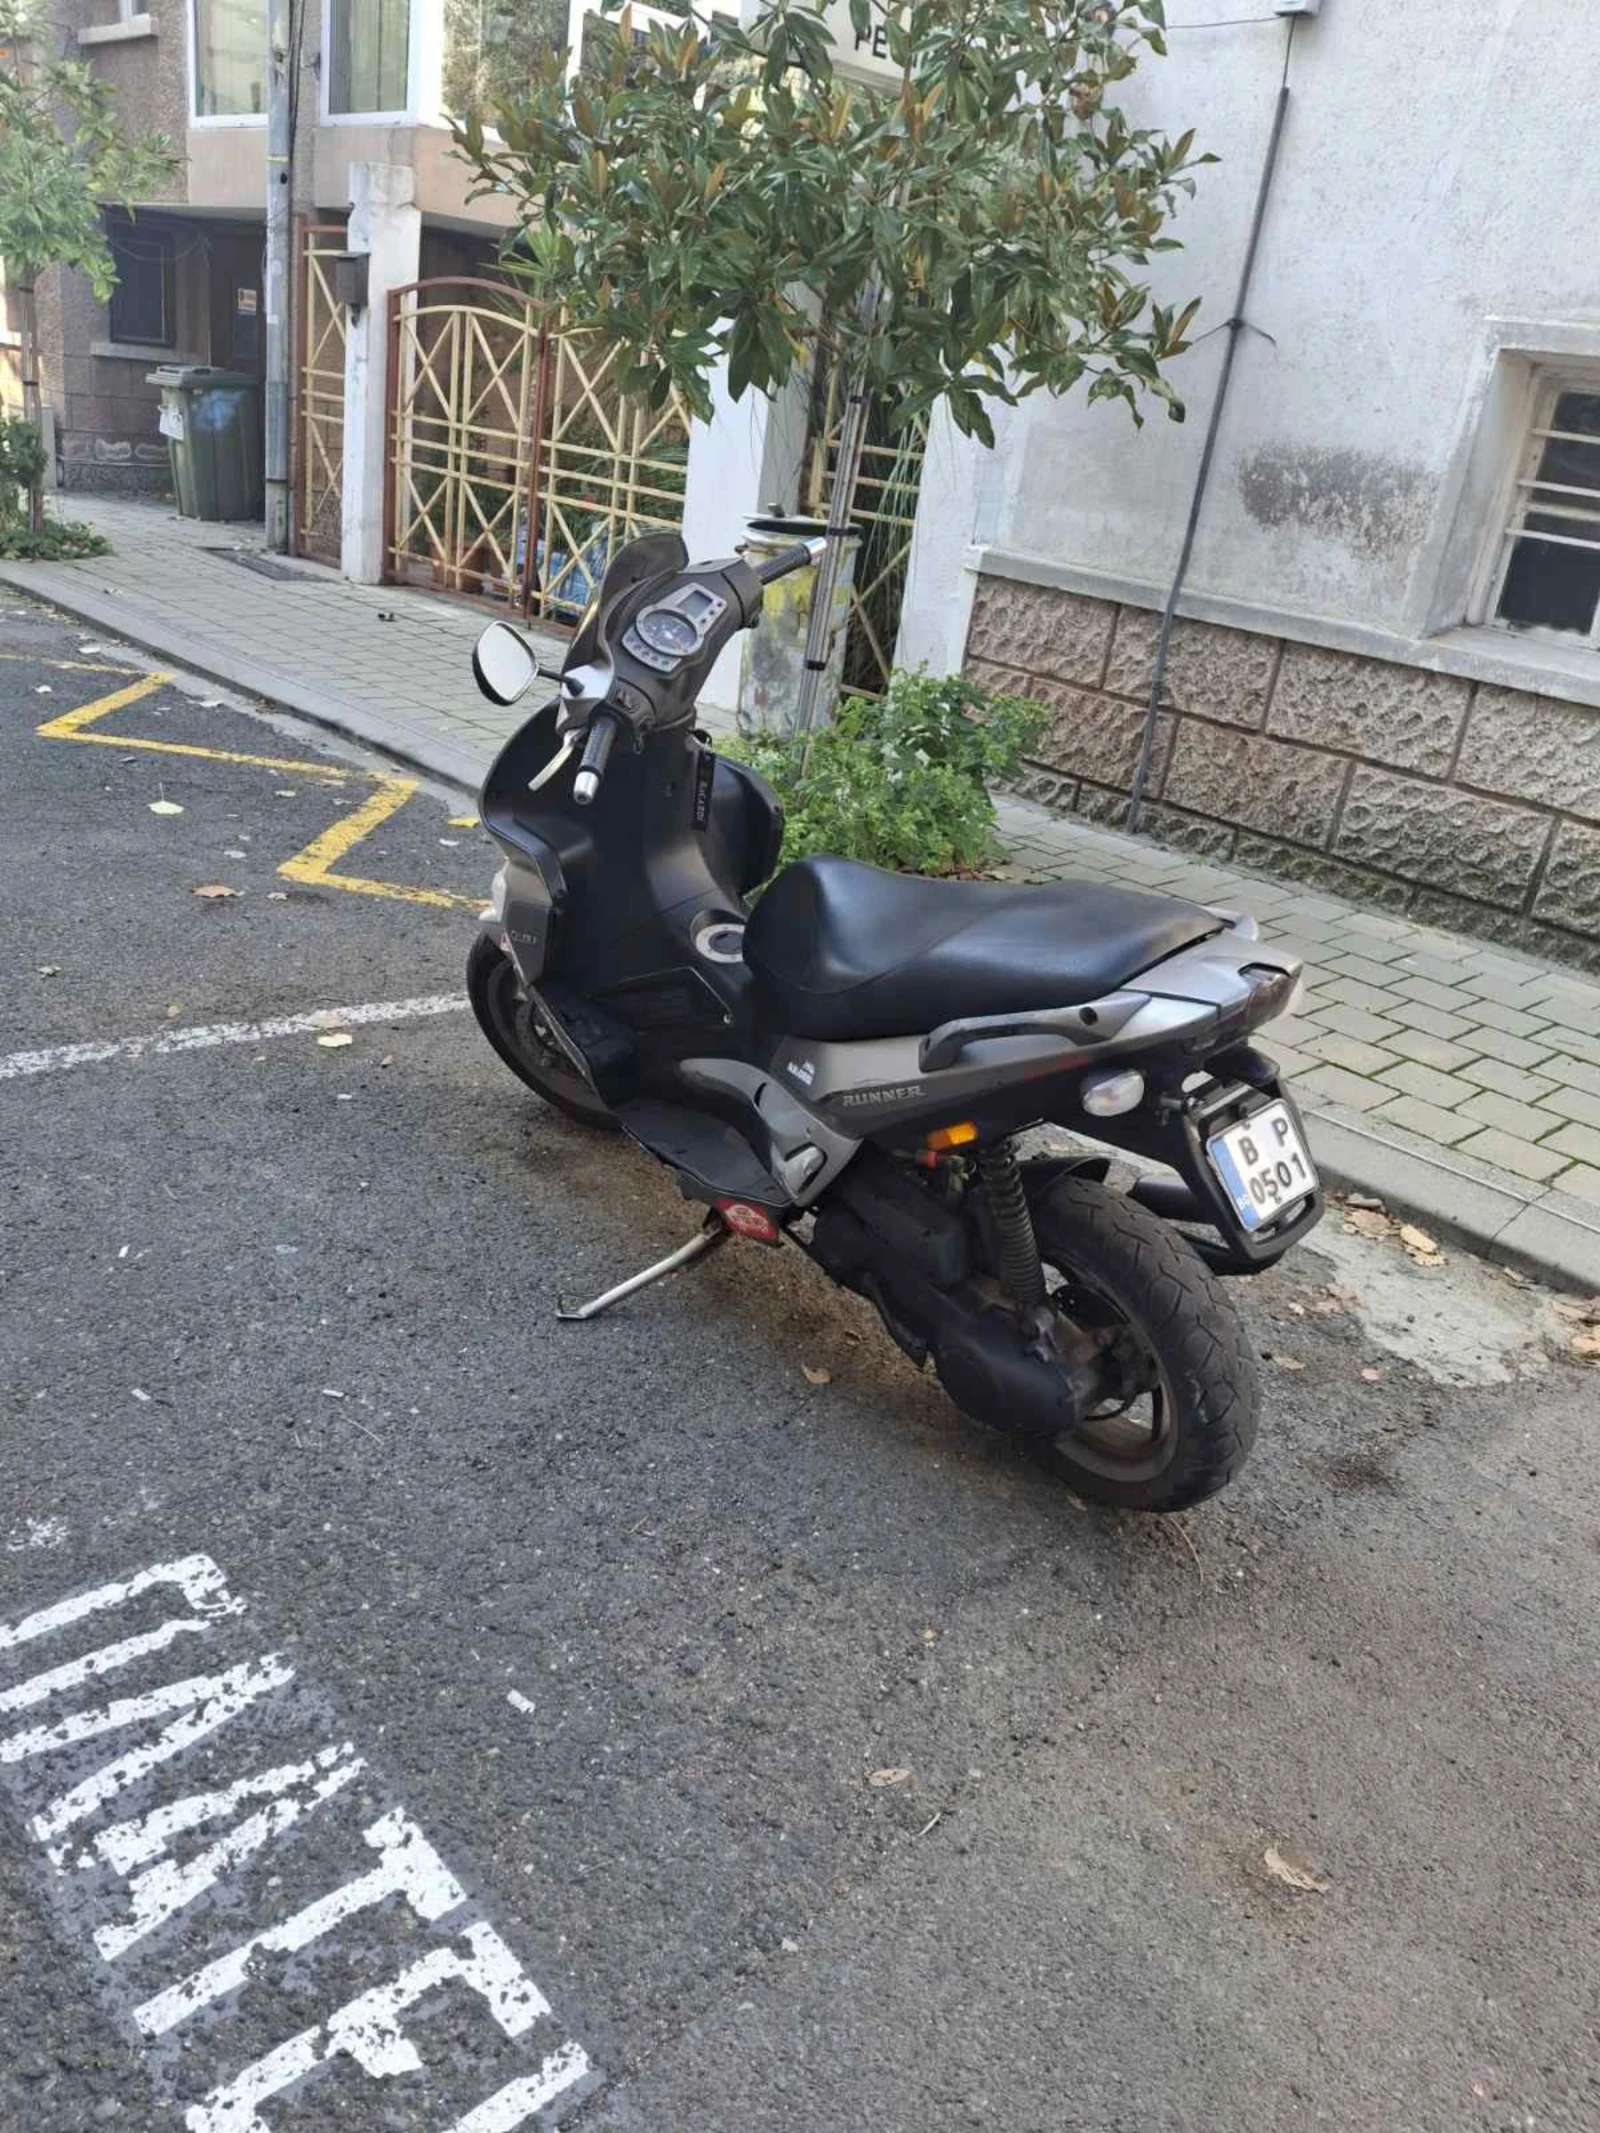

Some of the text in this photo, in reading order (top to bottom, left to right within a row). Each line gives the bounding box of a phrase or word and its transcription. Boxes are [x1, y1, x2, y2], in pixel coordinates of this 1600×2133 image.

[842, 1084, 927, 1107] RUNNER
[1238, 1117, 1289, 1167] B P
[1248, 1151, 1307, 1205] 0501
[0, 1553, 590, 2133] ПЛАТЕ
